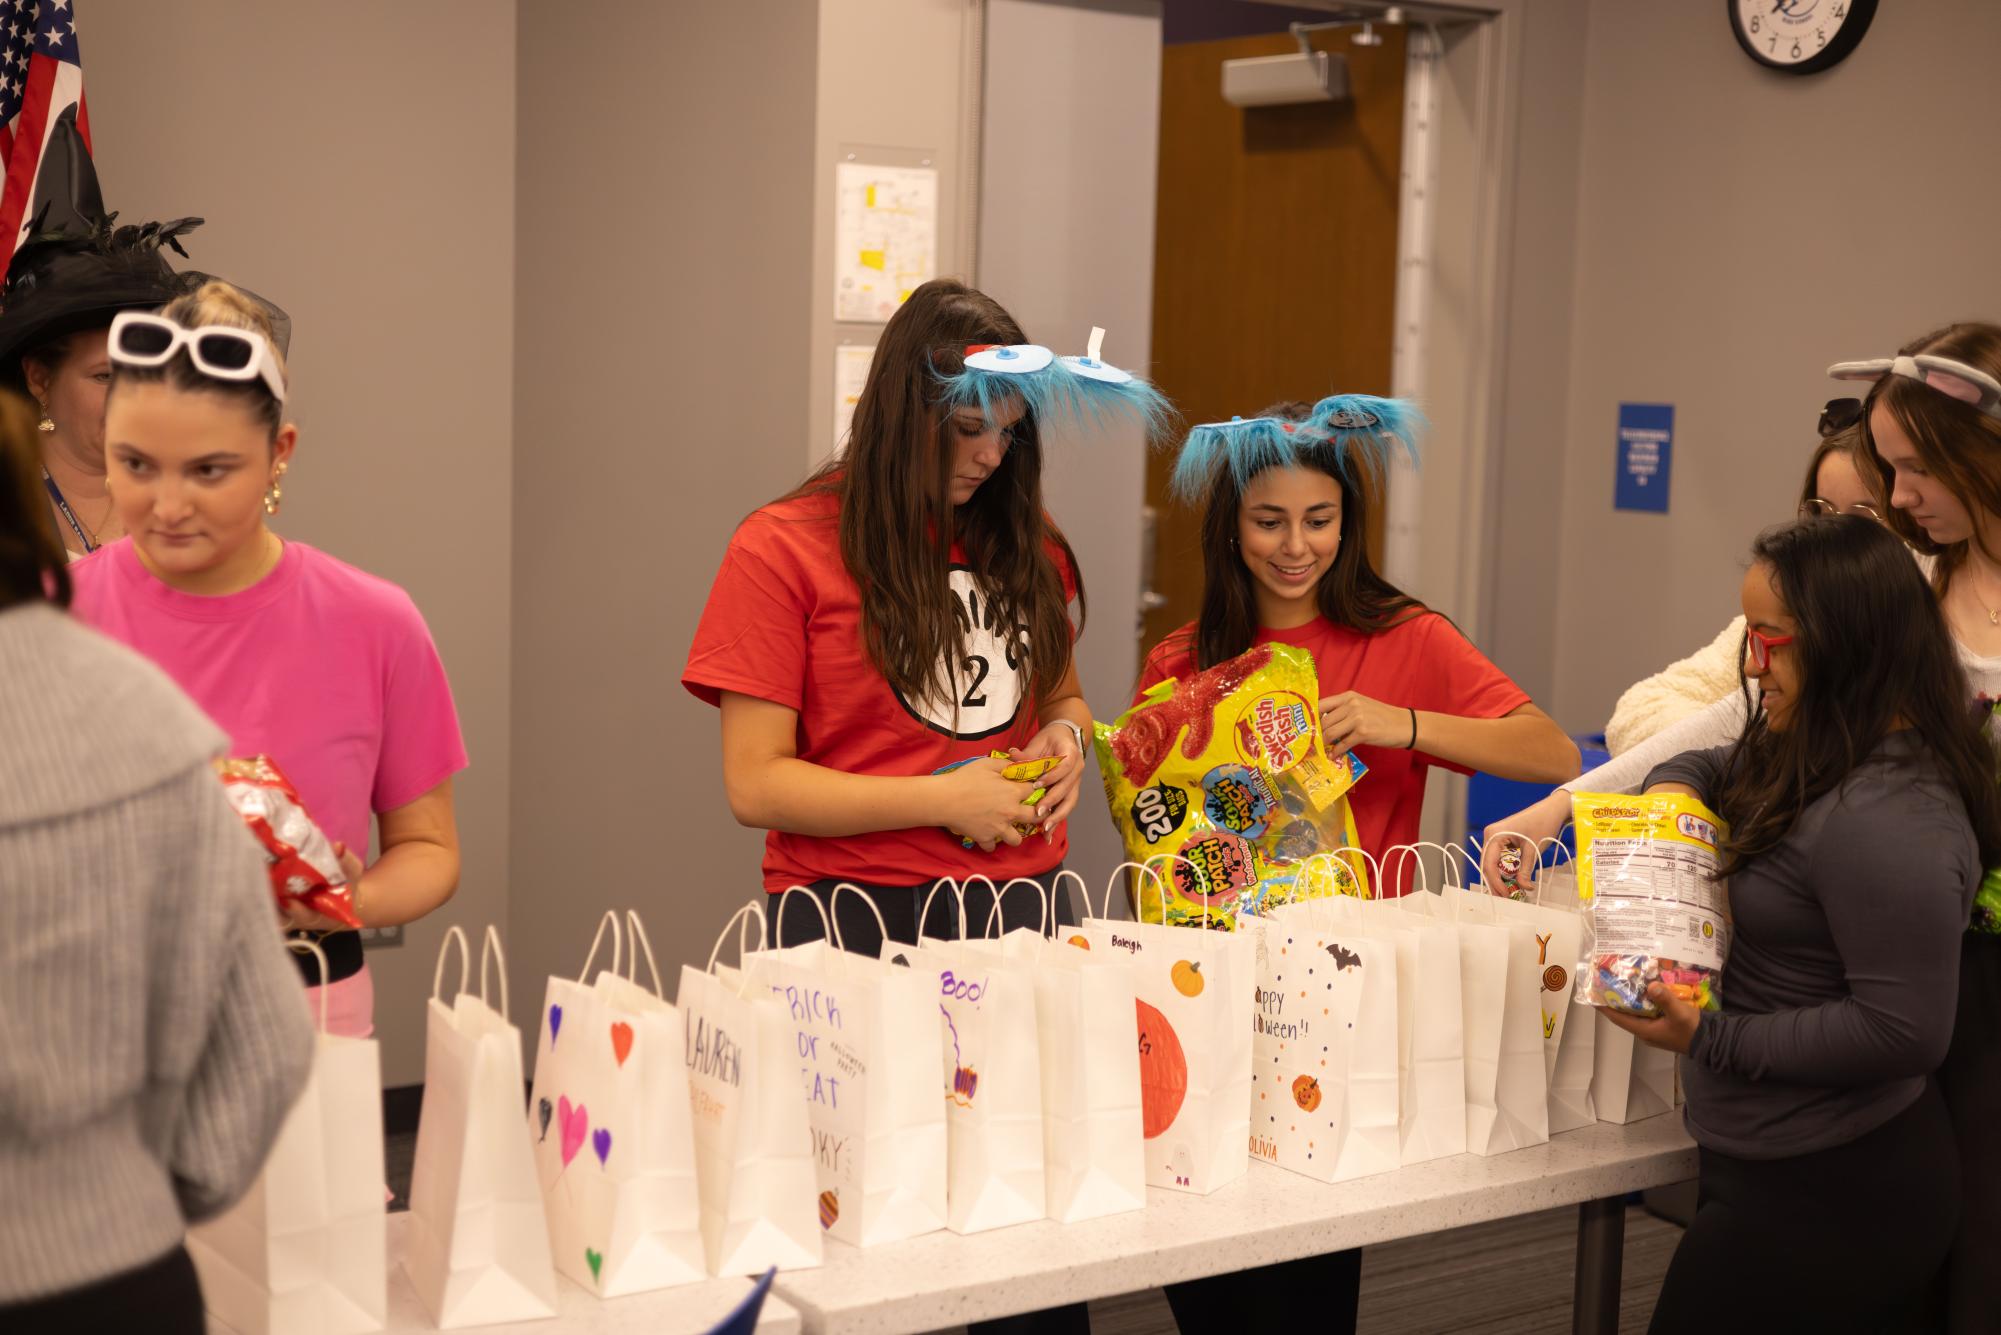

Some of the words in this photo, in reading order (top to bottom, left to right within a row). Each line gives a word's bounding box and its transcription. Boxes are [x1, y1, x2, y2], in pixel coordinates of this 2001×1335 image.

[1751, 15, 1760, 34] 8
[1768, 37, 1777, 53] 7
[1817, 31, 1826, 47] 5
[1790, 41, 1802, 59] 6
[962, 655, 989, 707] 2
[1256, 699, 1294, 769] Swedish
[1273, 706, 1297, 747] Fish
[1135, 789, 1173, 842] 200
[1211, 786, 1241, 831] SOUR
[1218, 779, 1254, 832] PATCH
[1187, 846, 1213, 895] SOUR
[1203, 838, 1232, 893] PATCH
[772, 985, 842, 1030] RICK
[685, 1007, 742, 1087] LAUREN
